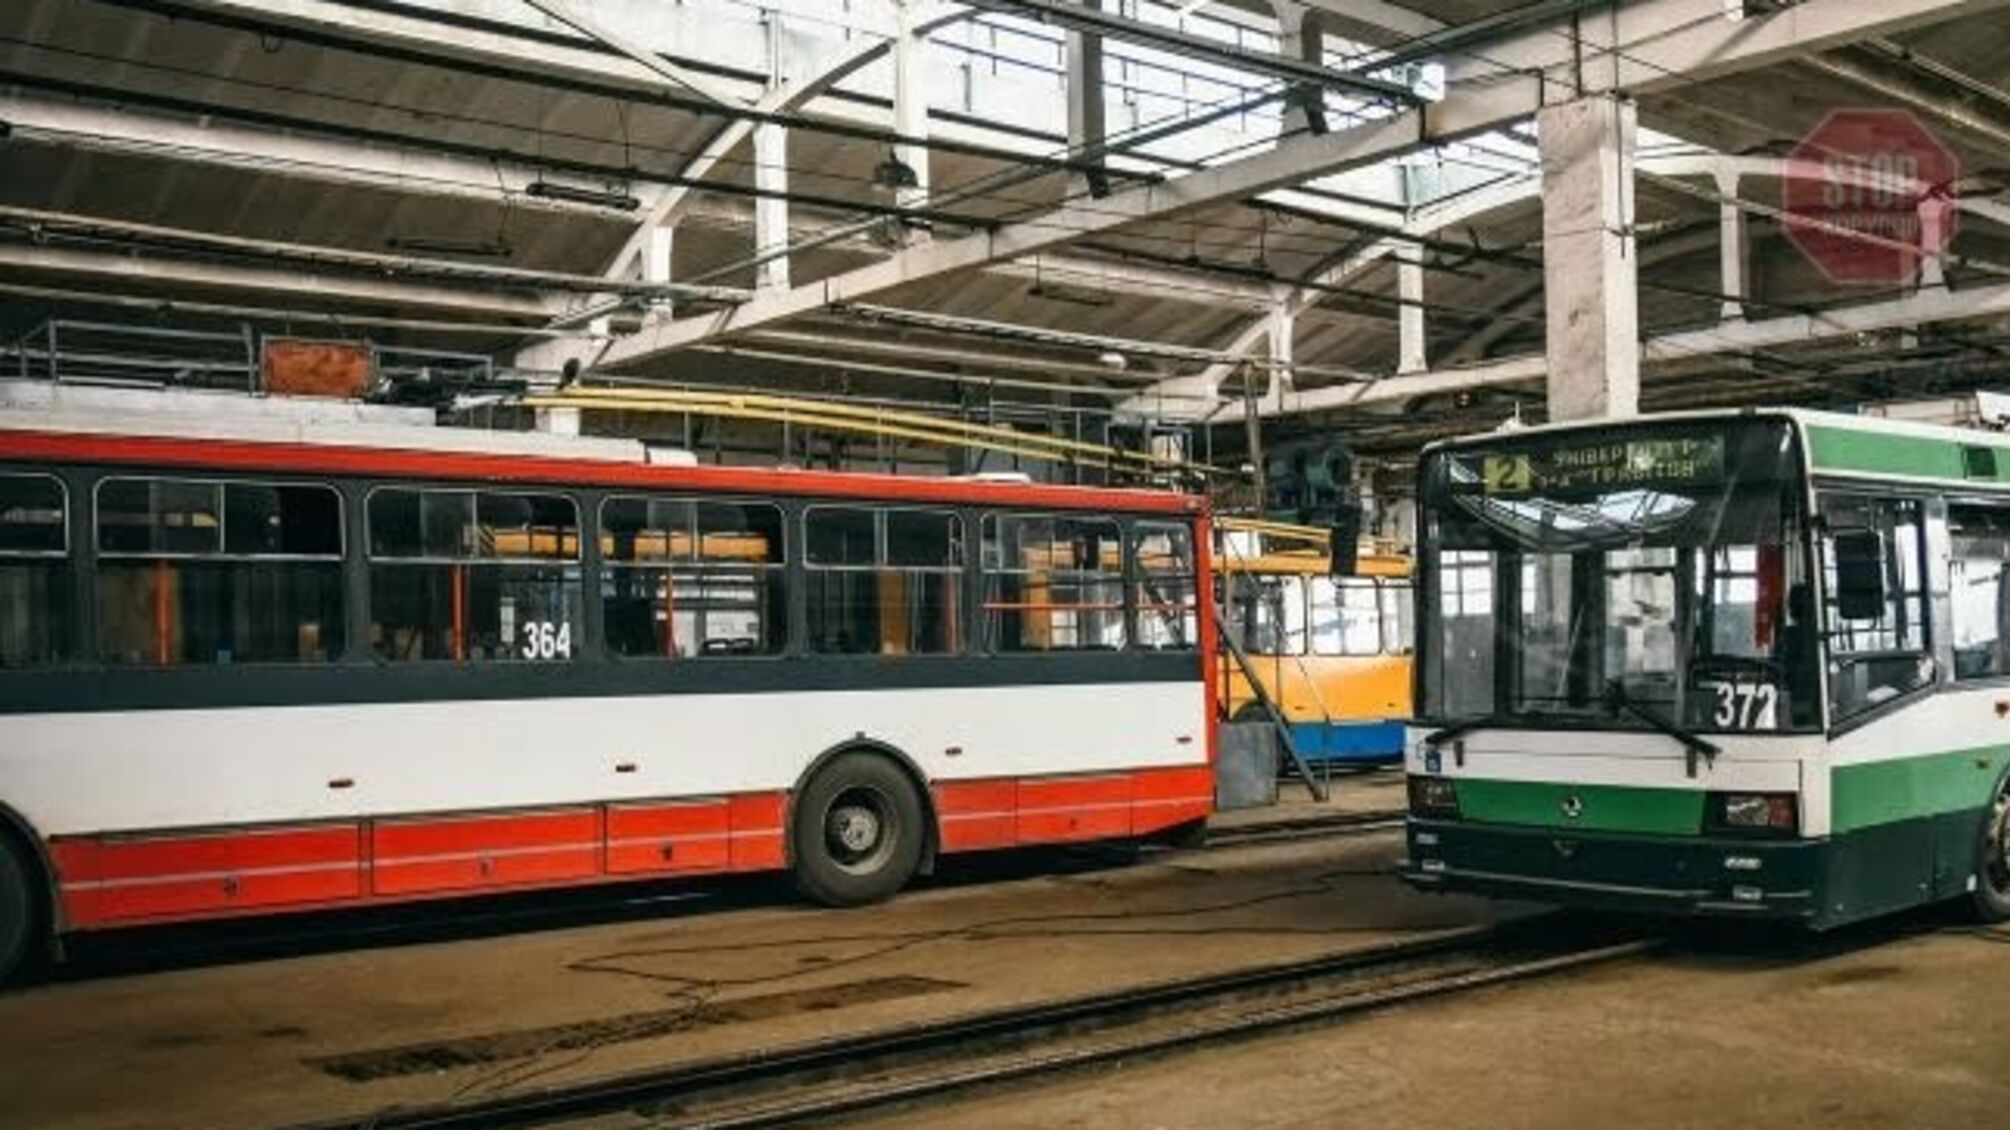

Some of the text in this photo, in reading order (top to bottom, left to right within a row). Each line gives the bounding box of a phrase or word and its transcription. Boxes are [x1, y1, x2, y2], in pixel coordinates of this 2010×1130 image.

[1496, 457, 1518, 490] 2
[521, 621, 571, 660] 364
[1714, 681, 1778, 730] 372
